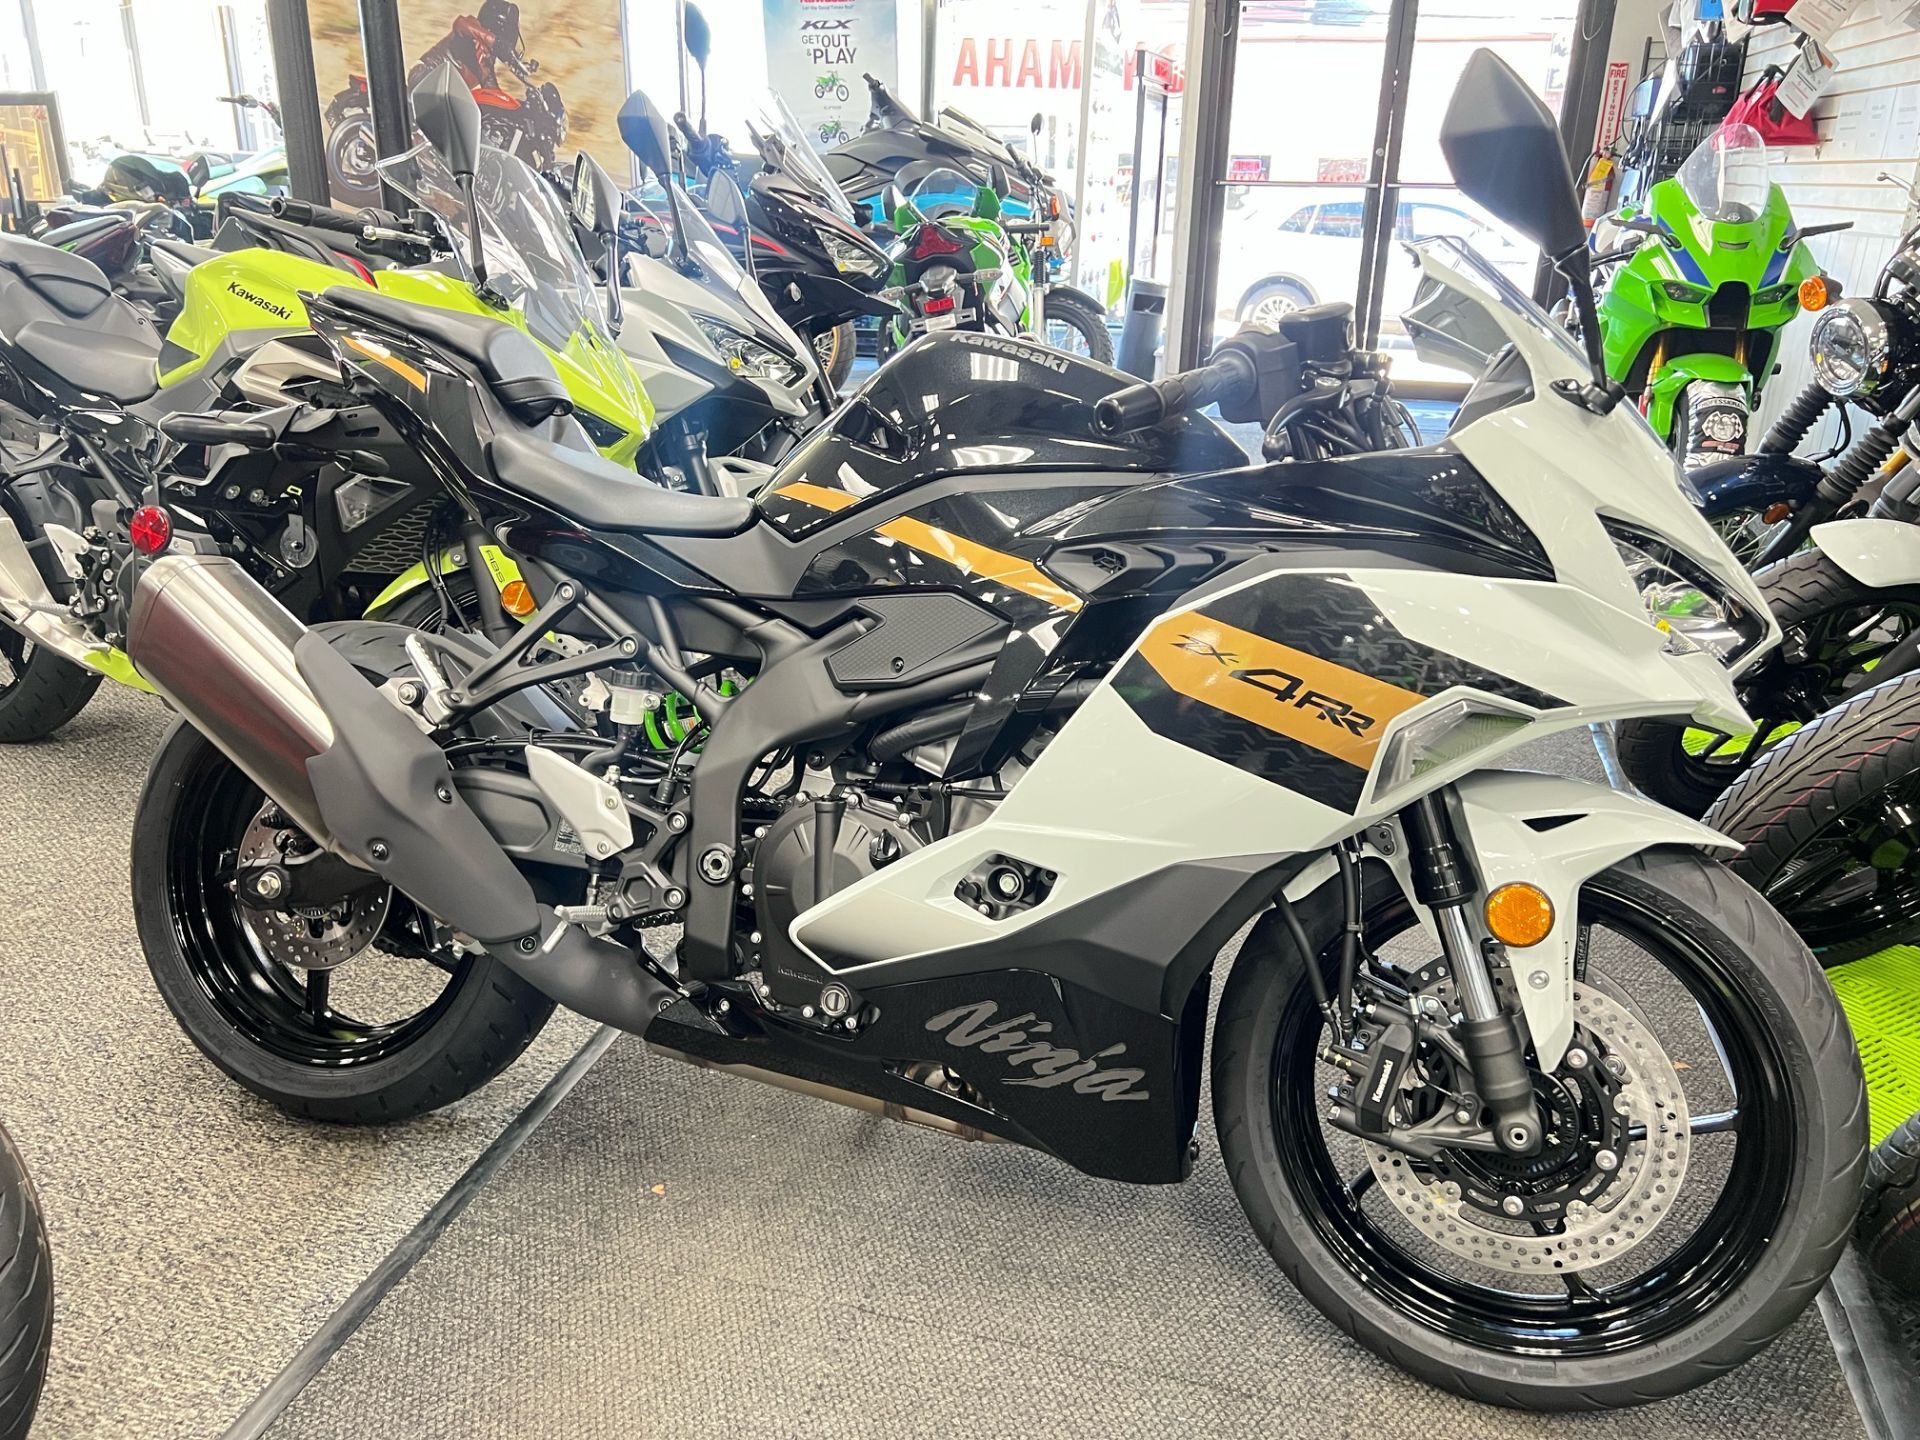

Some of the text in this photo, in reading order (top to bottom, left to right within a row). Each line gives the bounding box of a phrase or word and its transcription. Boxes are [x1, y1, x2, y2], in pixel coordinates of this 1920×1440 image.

[800, 19, 859, 30] KLX
[802, 34, 851, 48] GET OUT
[813, 47, 857, 64] PLAY
[1609, 69, 1627, 78] FIRE
[1604, 80, 1619, 146] EXTINGUISHE
[227, 281, 293, 320] Kawasaki
[950, 333, 1070, 374] Kawasaki
[485, 549, 505, 583] ABS
[925, 1000, 1150, 1101] Ninja
